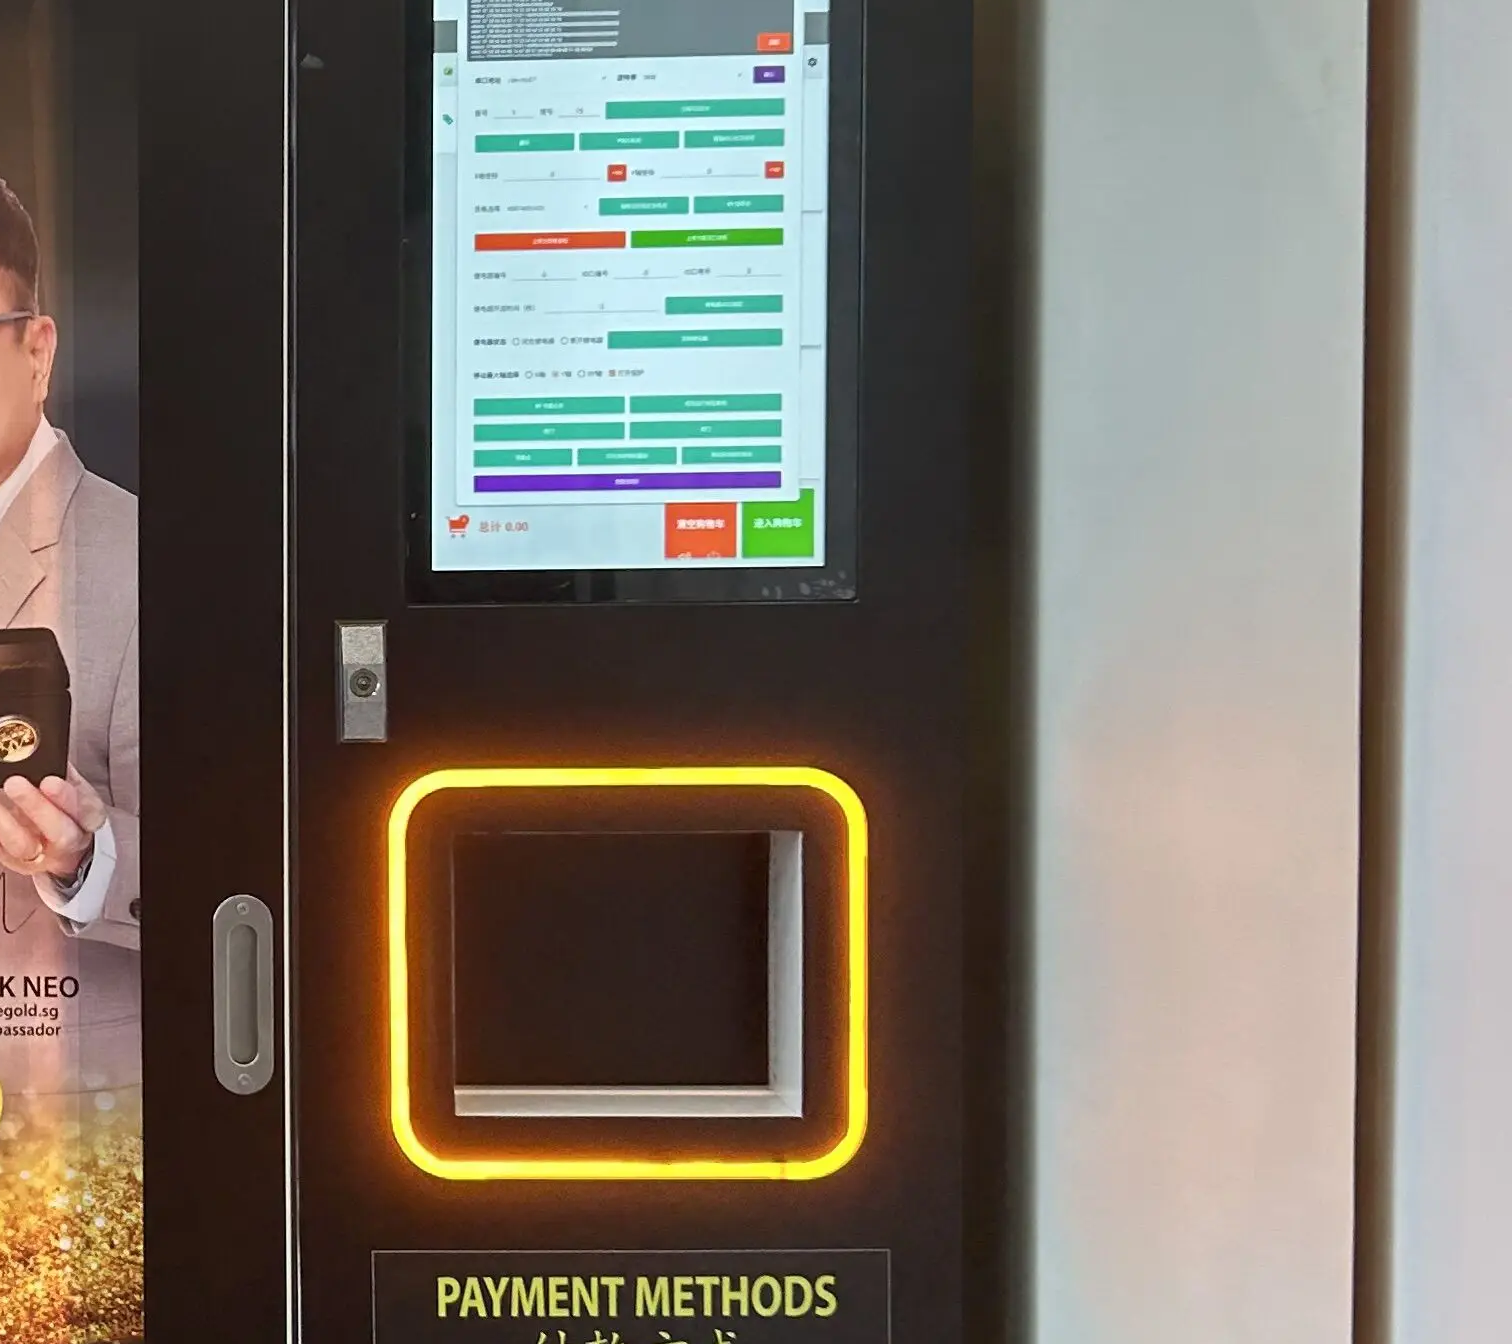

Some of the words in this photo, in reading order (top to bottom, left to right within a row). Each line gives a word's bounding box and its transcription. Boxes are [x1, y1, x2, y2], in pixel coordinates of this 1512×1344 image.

[24, 976, 80, 998] NEO
[436, 1275, 625, 1317] PAYMENT
[635, 1275, 838, 1317] METHODS
